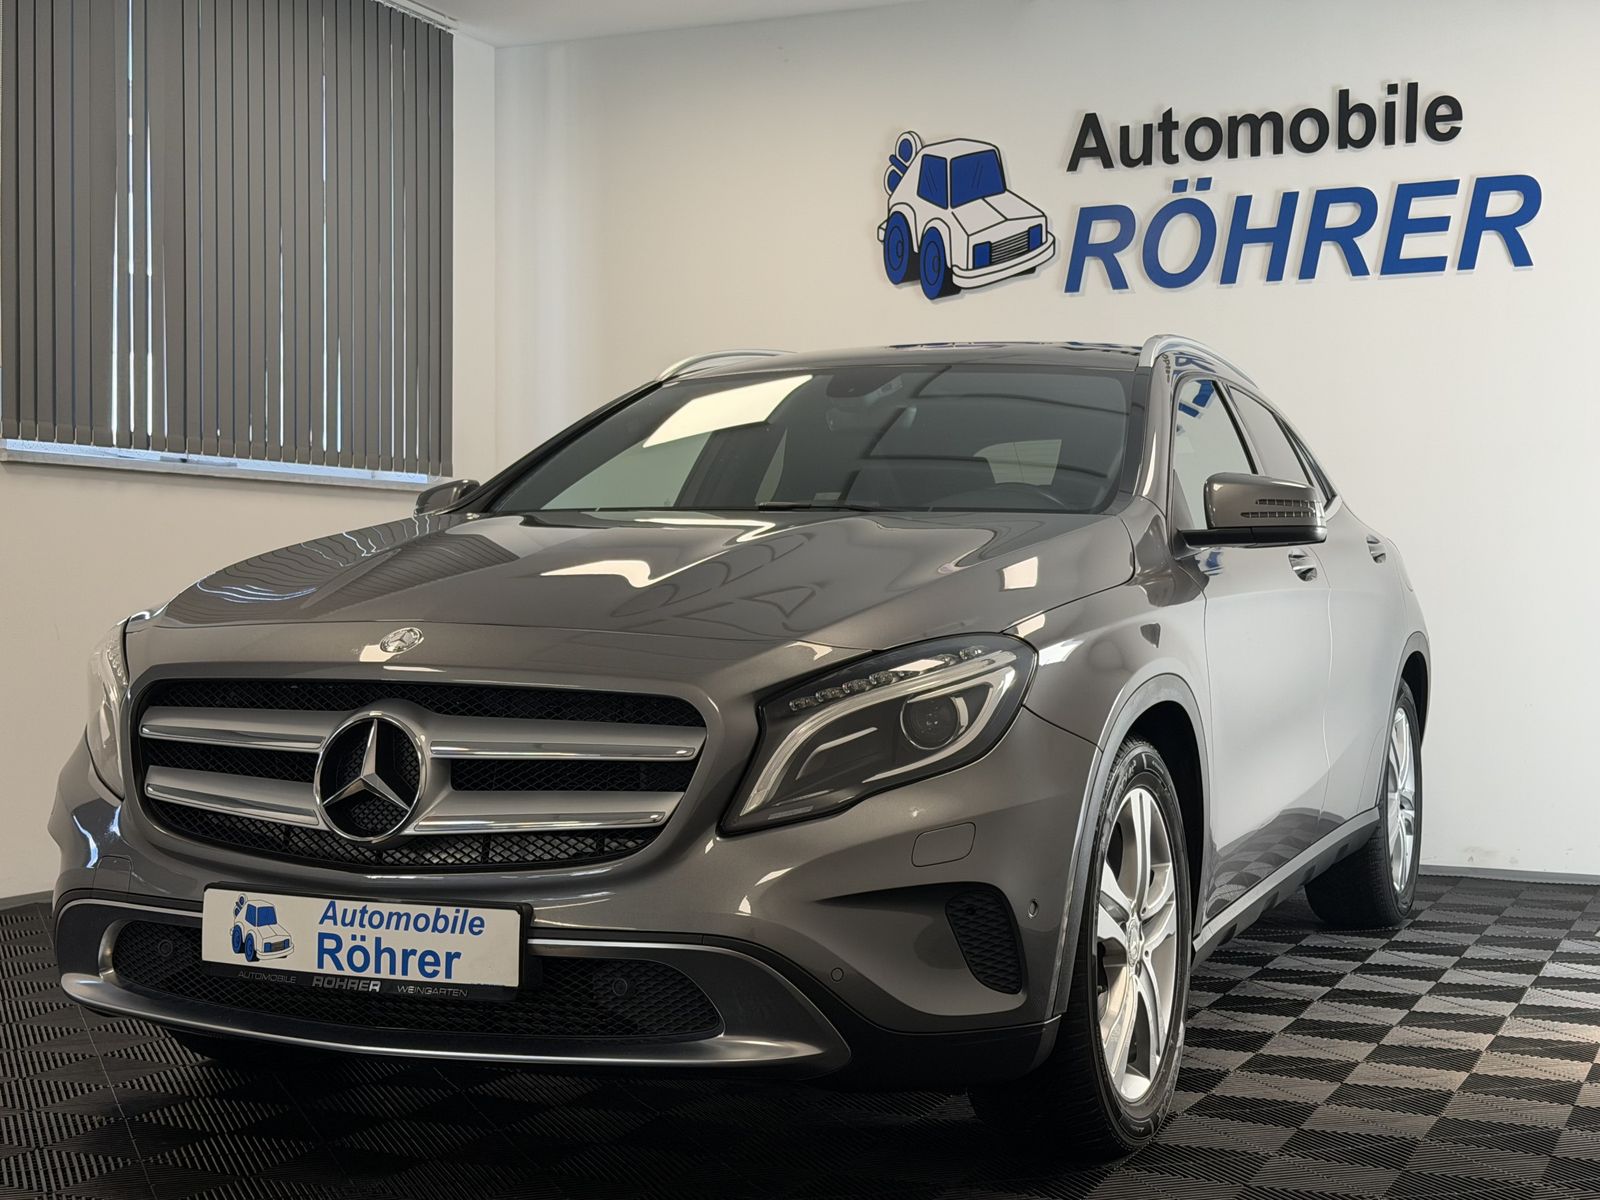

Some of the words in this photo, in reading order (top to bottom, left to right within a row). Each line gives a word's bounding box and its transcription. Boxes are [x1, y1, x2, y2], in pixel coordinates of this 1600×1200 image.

[1067, 81, 1464, 172] Automobile
[1064, 174, 1543, 295] RÖHRER
[319, 900, 486, 936] Automobile
[317, 932, 462, 979] Röhrer
[238, 970, 297, 984] AUTOMOBILE
[397, 985, 468, 998] WEINGARTEN
